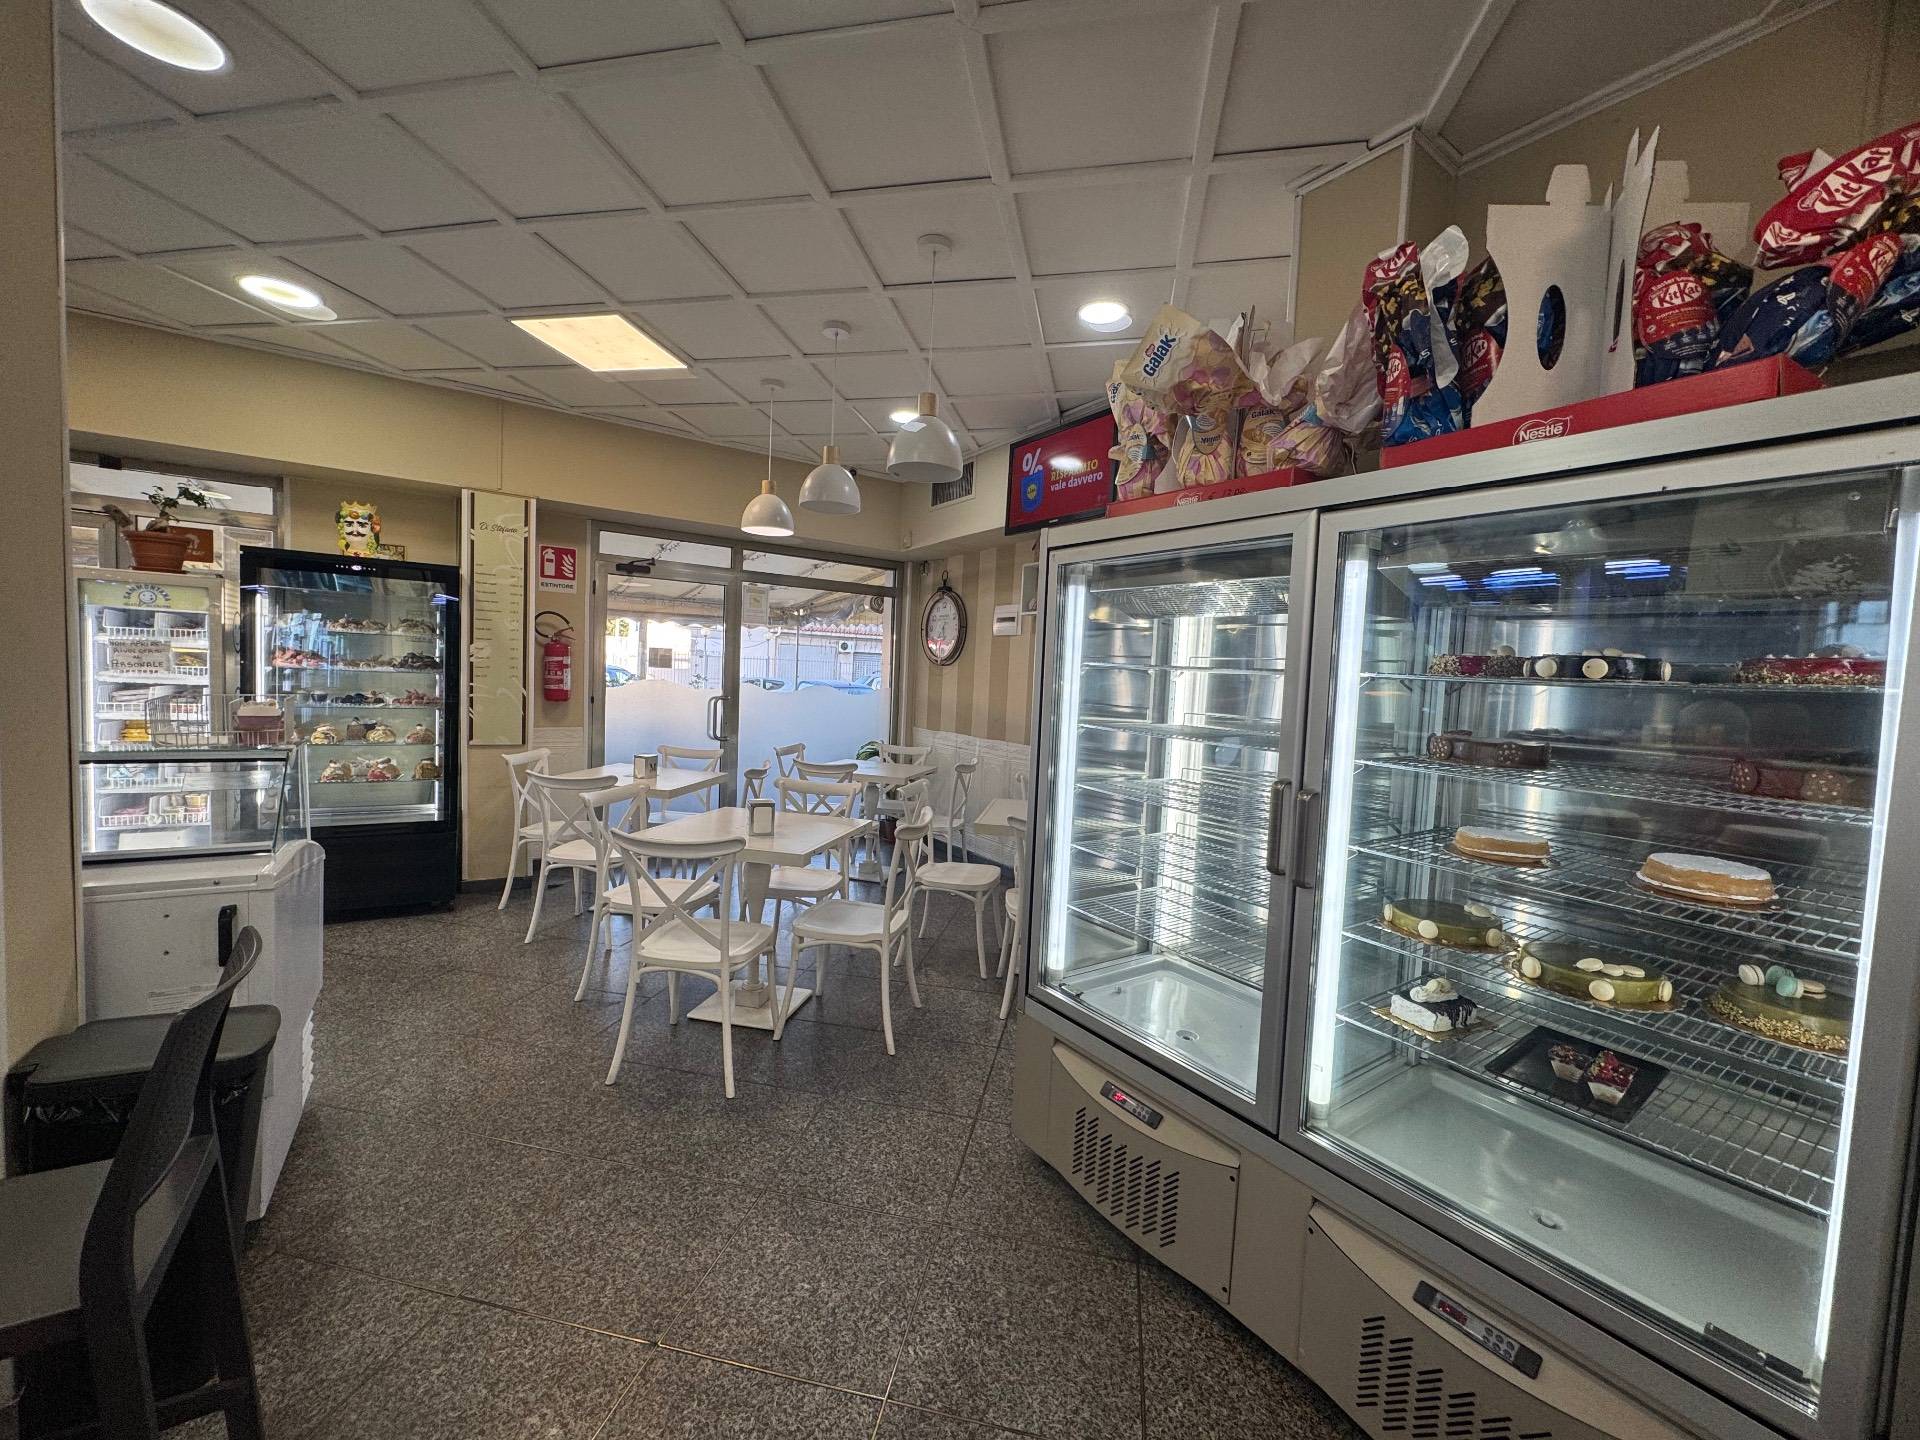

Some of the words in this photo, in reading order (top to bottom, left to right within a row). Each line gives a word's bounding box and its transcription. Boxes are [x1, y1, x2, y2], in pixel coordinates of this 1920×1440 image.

[1820, 149, 1895, 208] KitKat
[1655, 282, 1701, 307] KitKat
[1143, 335, 1176, 376] Galak
[1519, 422, 1564, 442] Nestlé
[1050, 481, 1066, 492] vale
[1067, 471, 1103, 488] davvero
[541, 582, 574, 590] ESTINTORE
